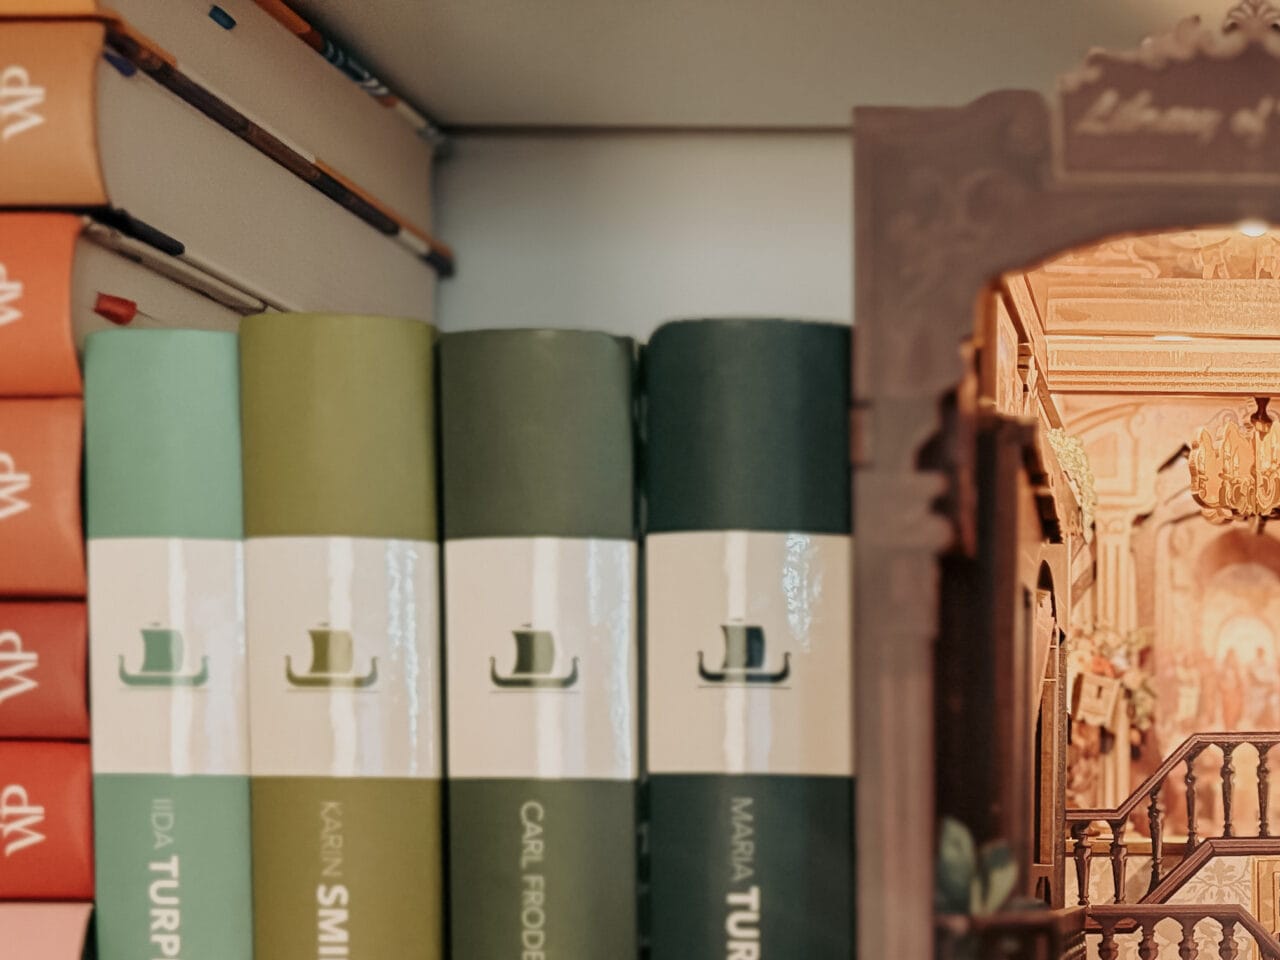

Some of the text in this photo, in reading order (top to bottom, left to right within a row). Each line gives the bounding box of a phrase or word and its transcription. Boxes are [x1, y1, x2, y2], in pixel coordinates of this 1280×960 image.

[0, 784, 46, 857] WP
[151, 798, 175, 850] IIDA
[320, 800, 343, 878] KARIN
[519, 800, 545, 869] CARL
[730, 797, 755, 882] MARIA
